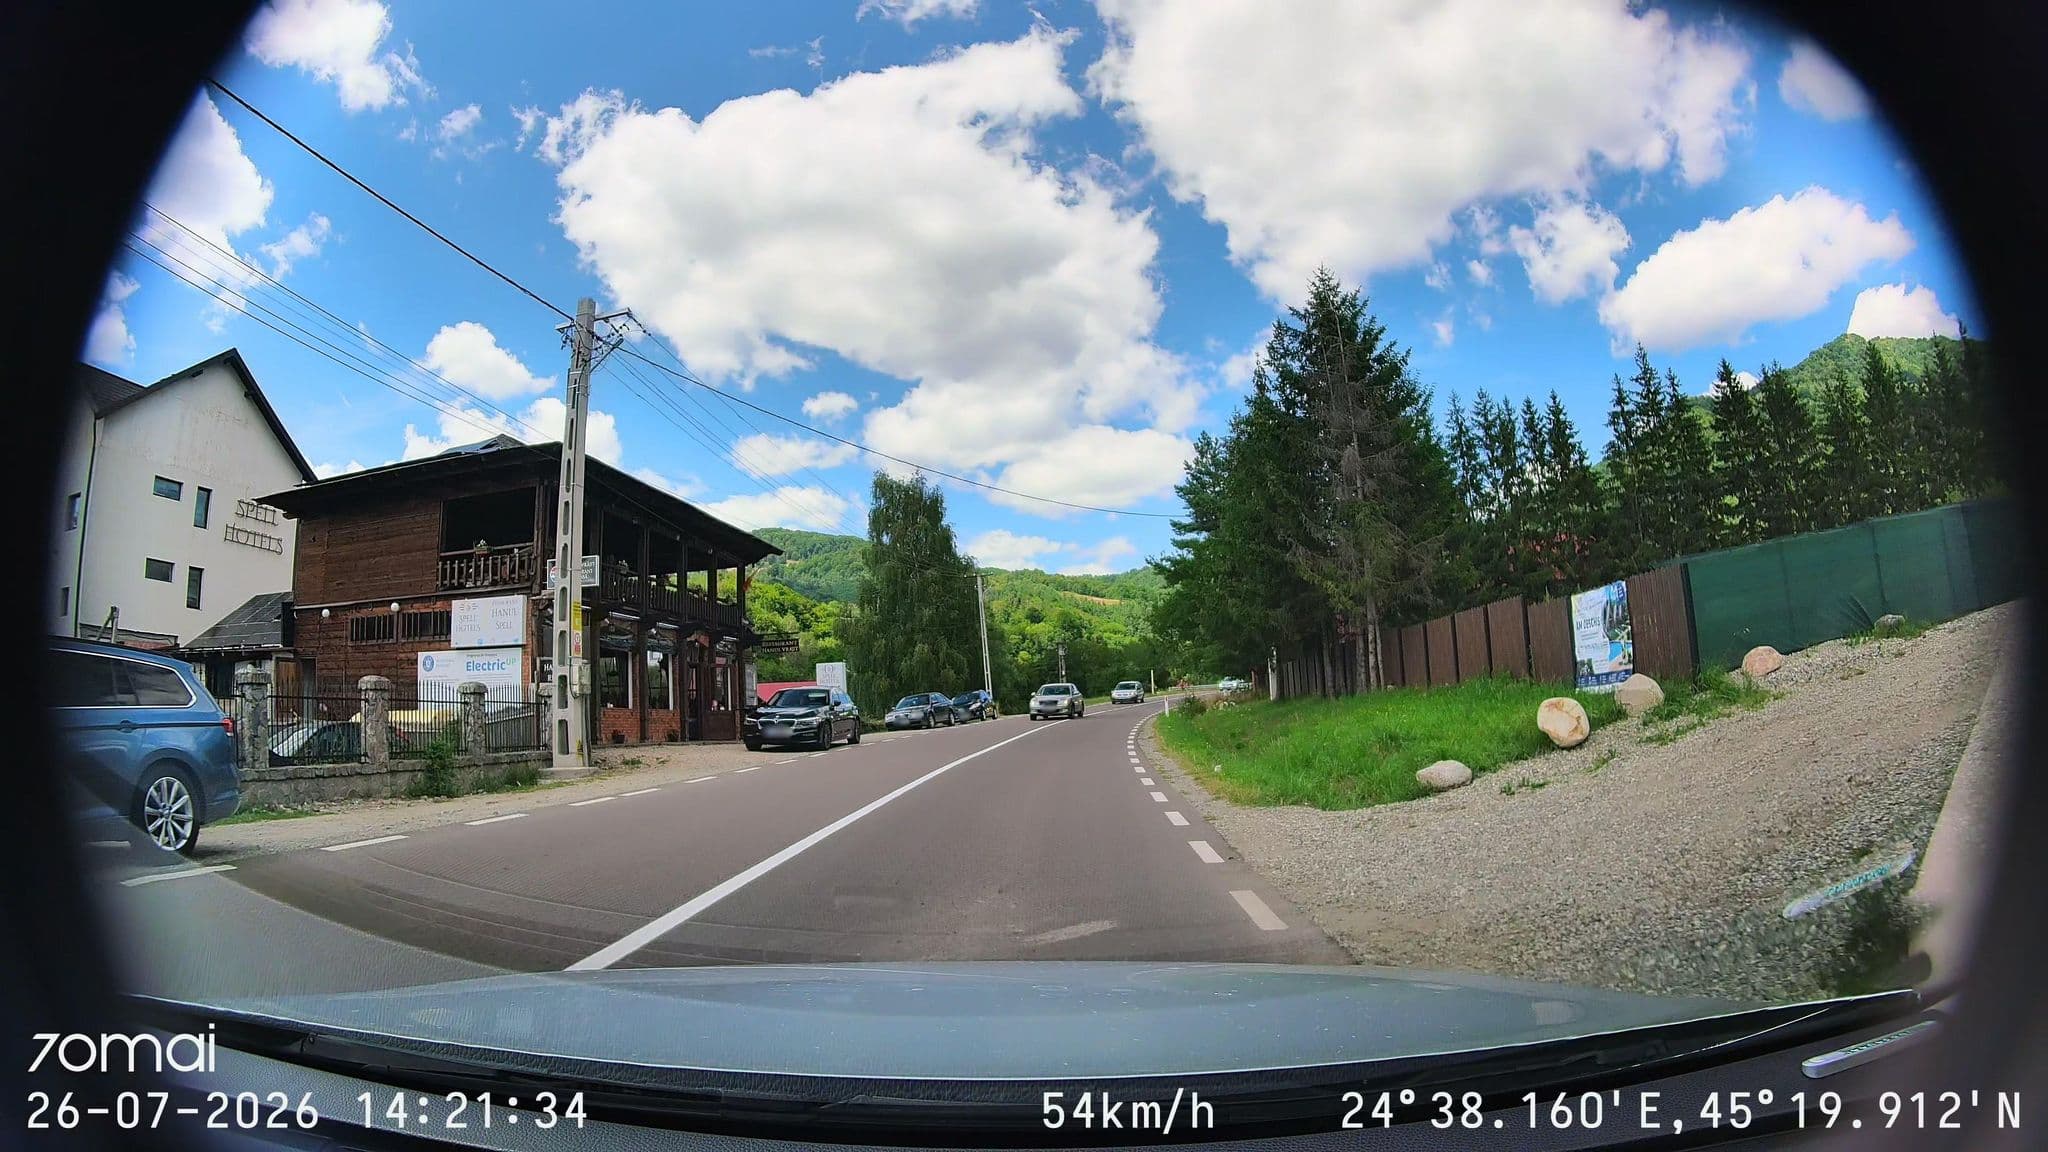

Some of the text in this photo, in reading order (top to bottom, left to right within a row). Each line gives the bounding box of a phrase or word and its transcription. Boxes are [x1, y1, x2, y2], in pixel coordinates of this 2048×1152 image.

[235, 499, 278, 526] SPELL
[224, 522, 283, 555] HOTELS
[466, 659, 506, 671] Electric
